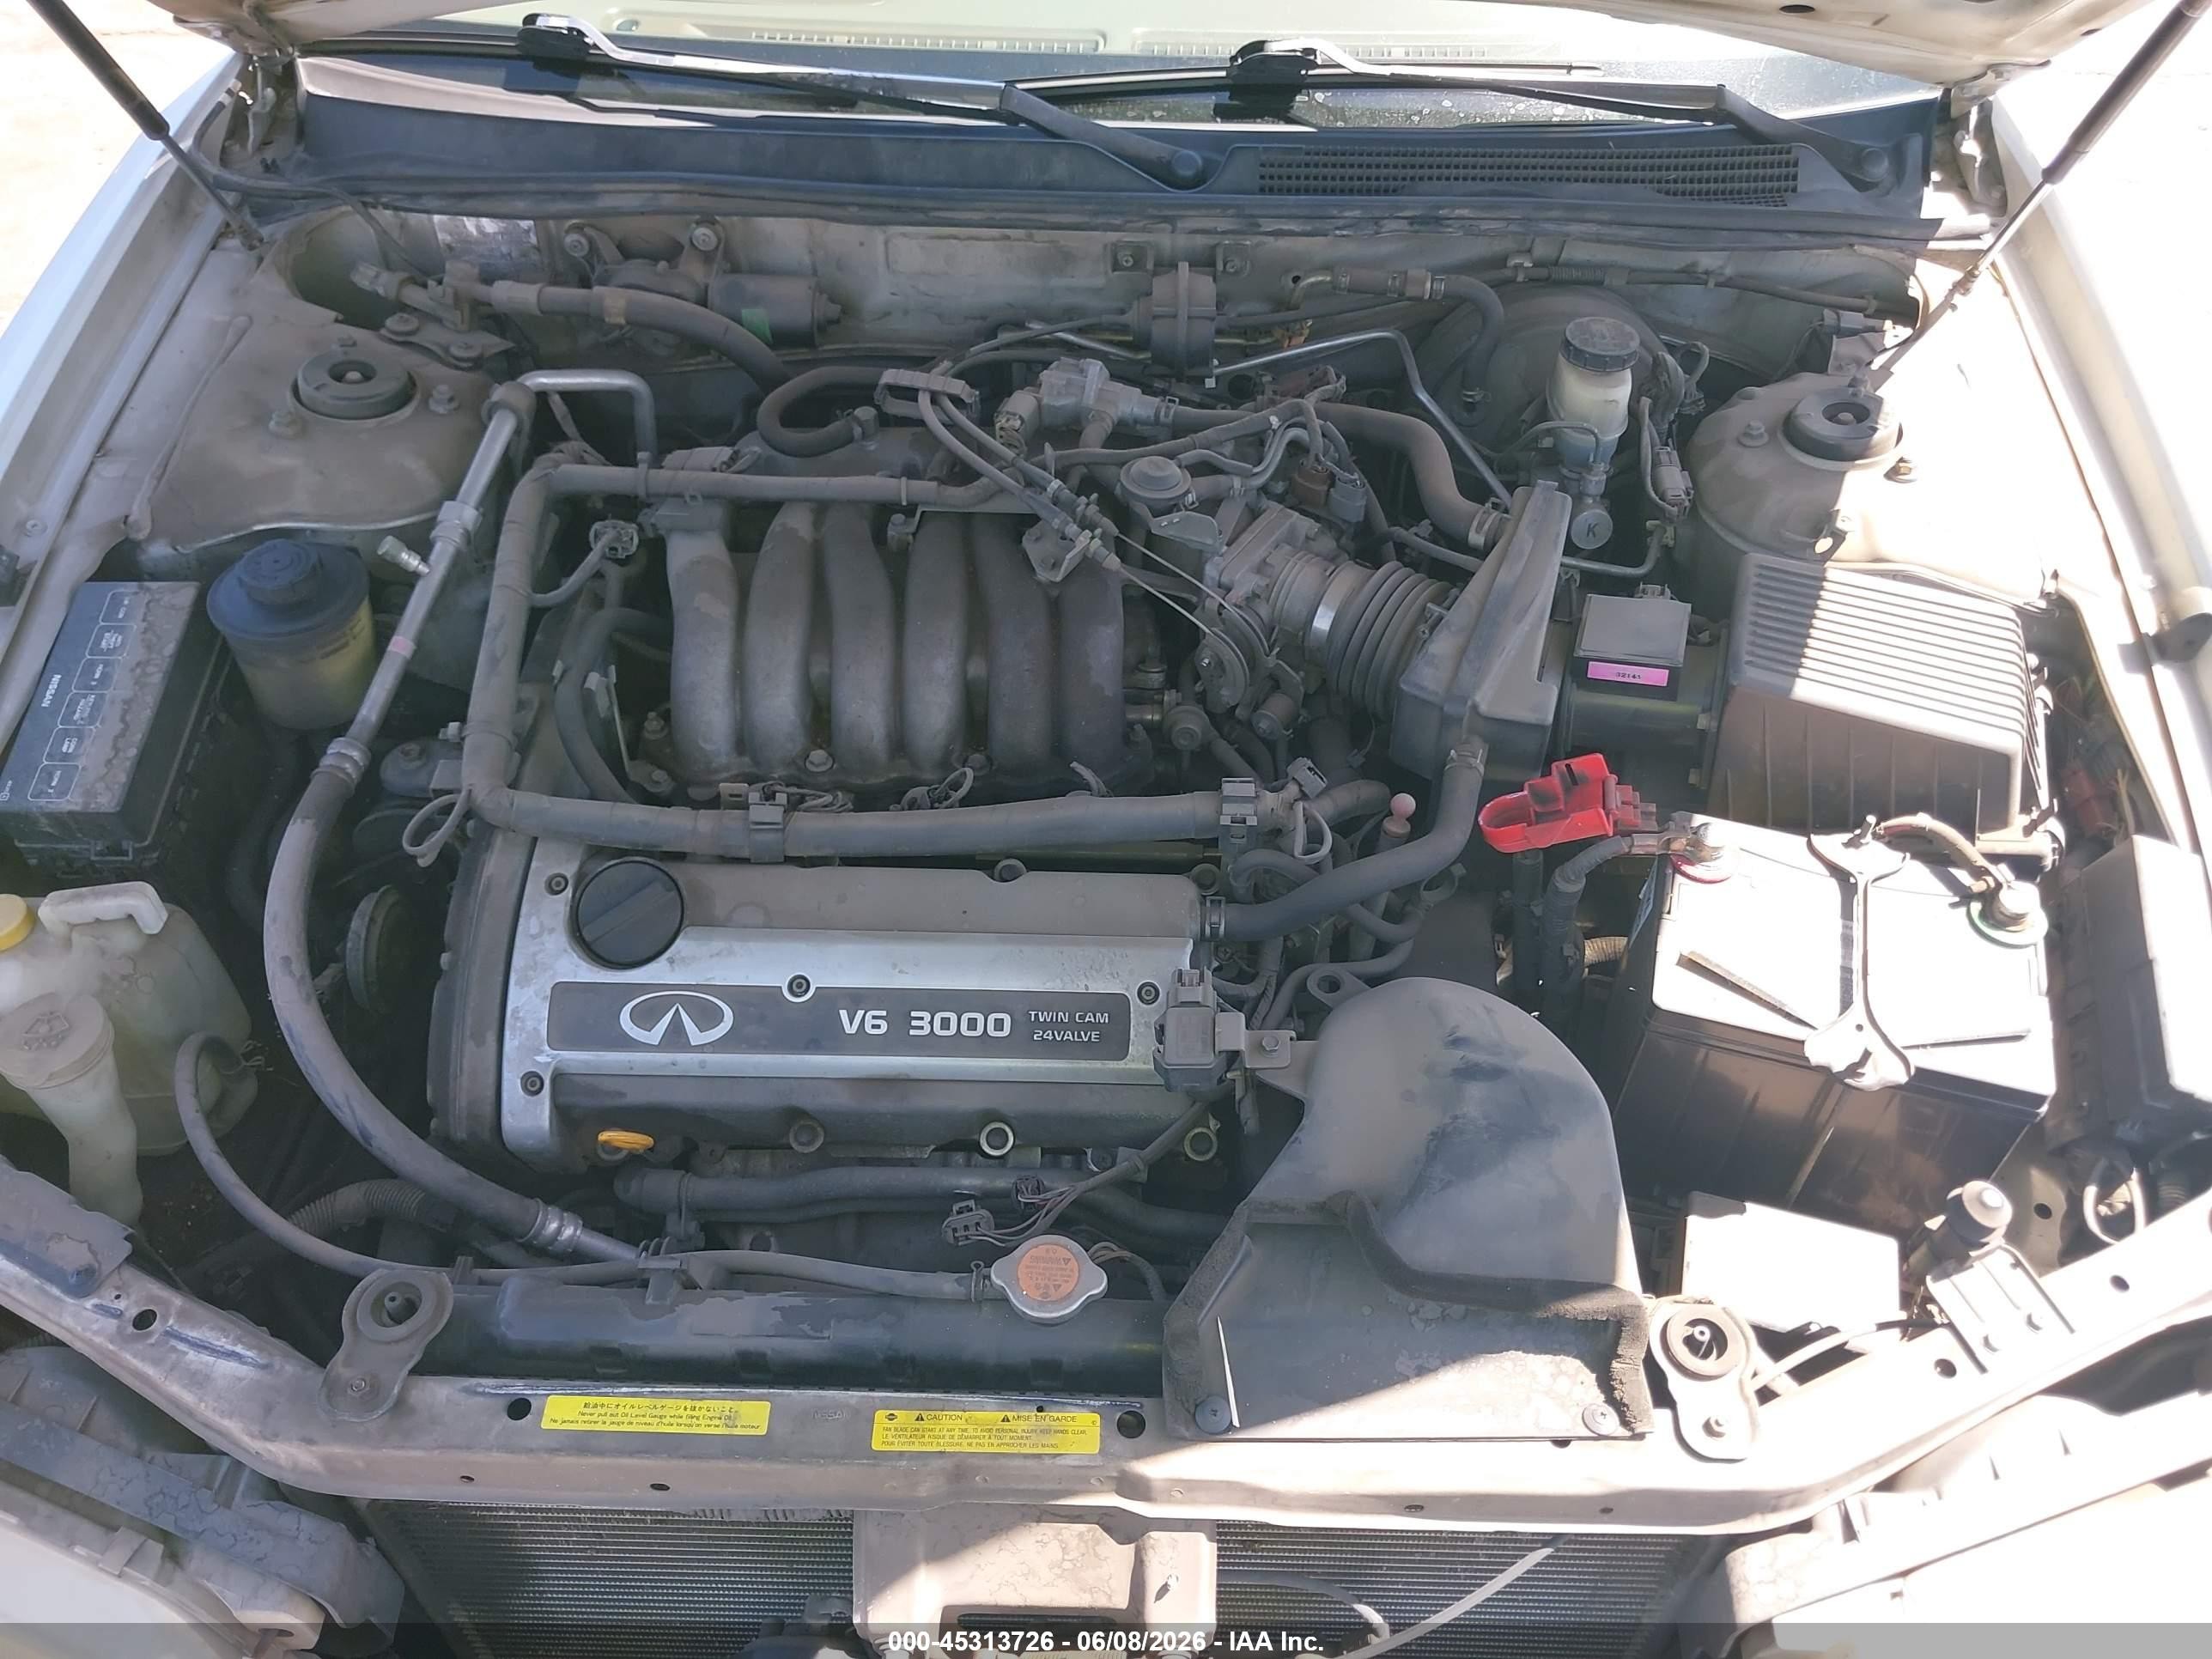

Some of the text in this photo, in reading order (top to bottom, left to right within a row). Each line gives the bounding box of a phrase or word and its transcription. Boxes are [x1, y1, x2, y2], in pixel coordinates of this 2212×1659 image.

[1586, 522, 1599, 538] K
[41, 674, 62, 707] NISSAN
[839, 1009, 1109, 1038] V6 3000 TWIN CAM
[1033, 1030, 1100, 1042] 24VALVE
